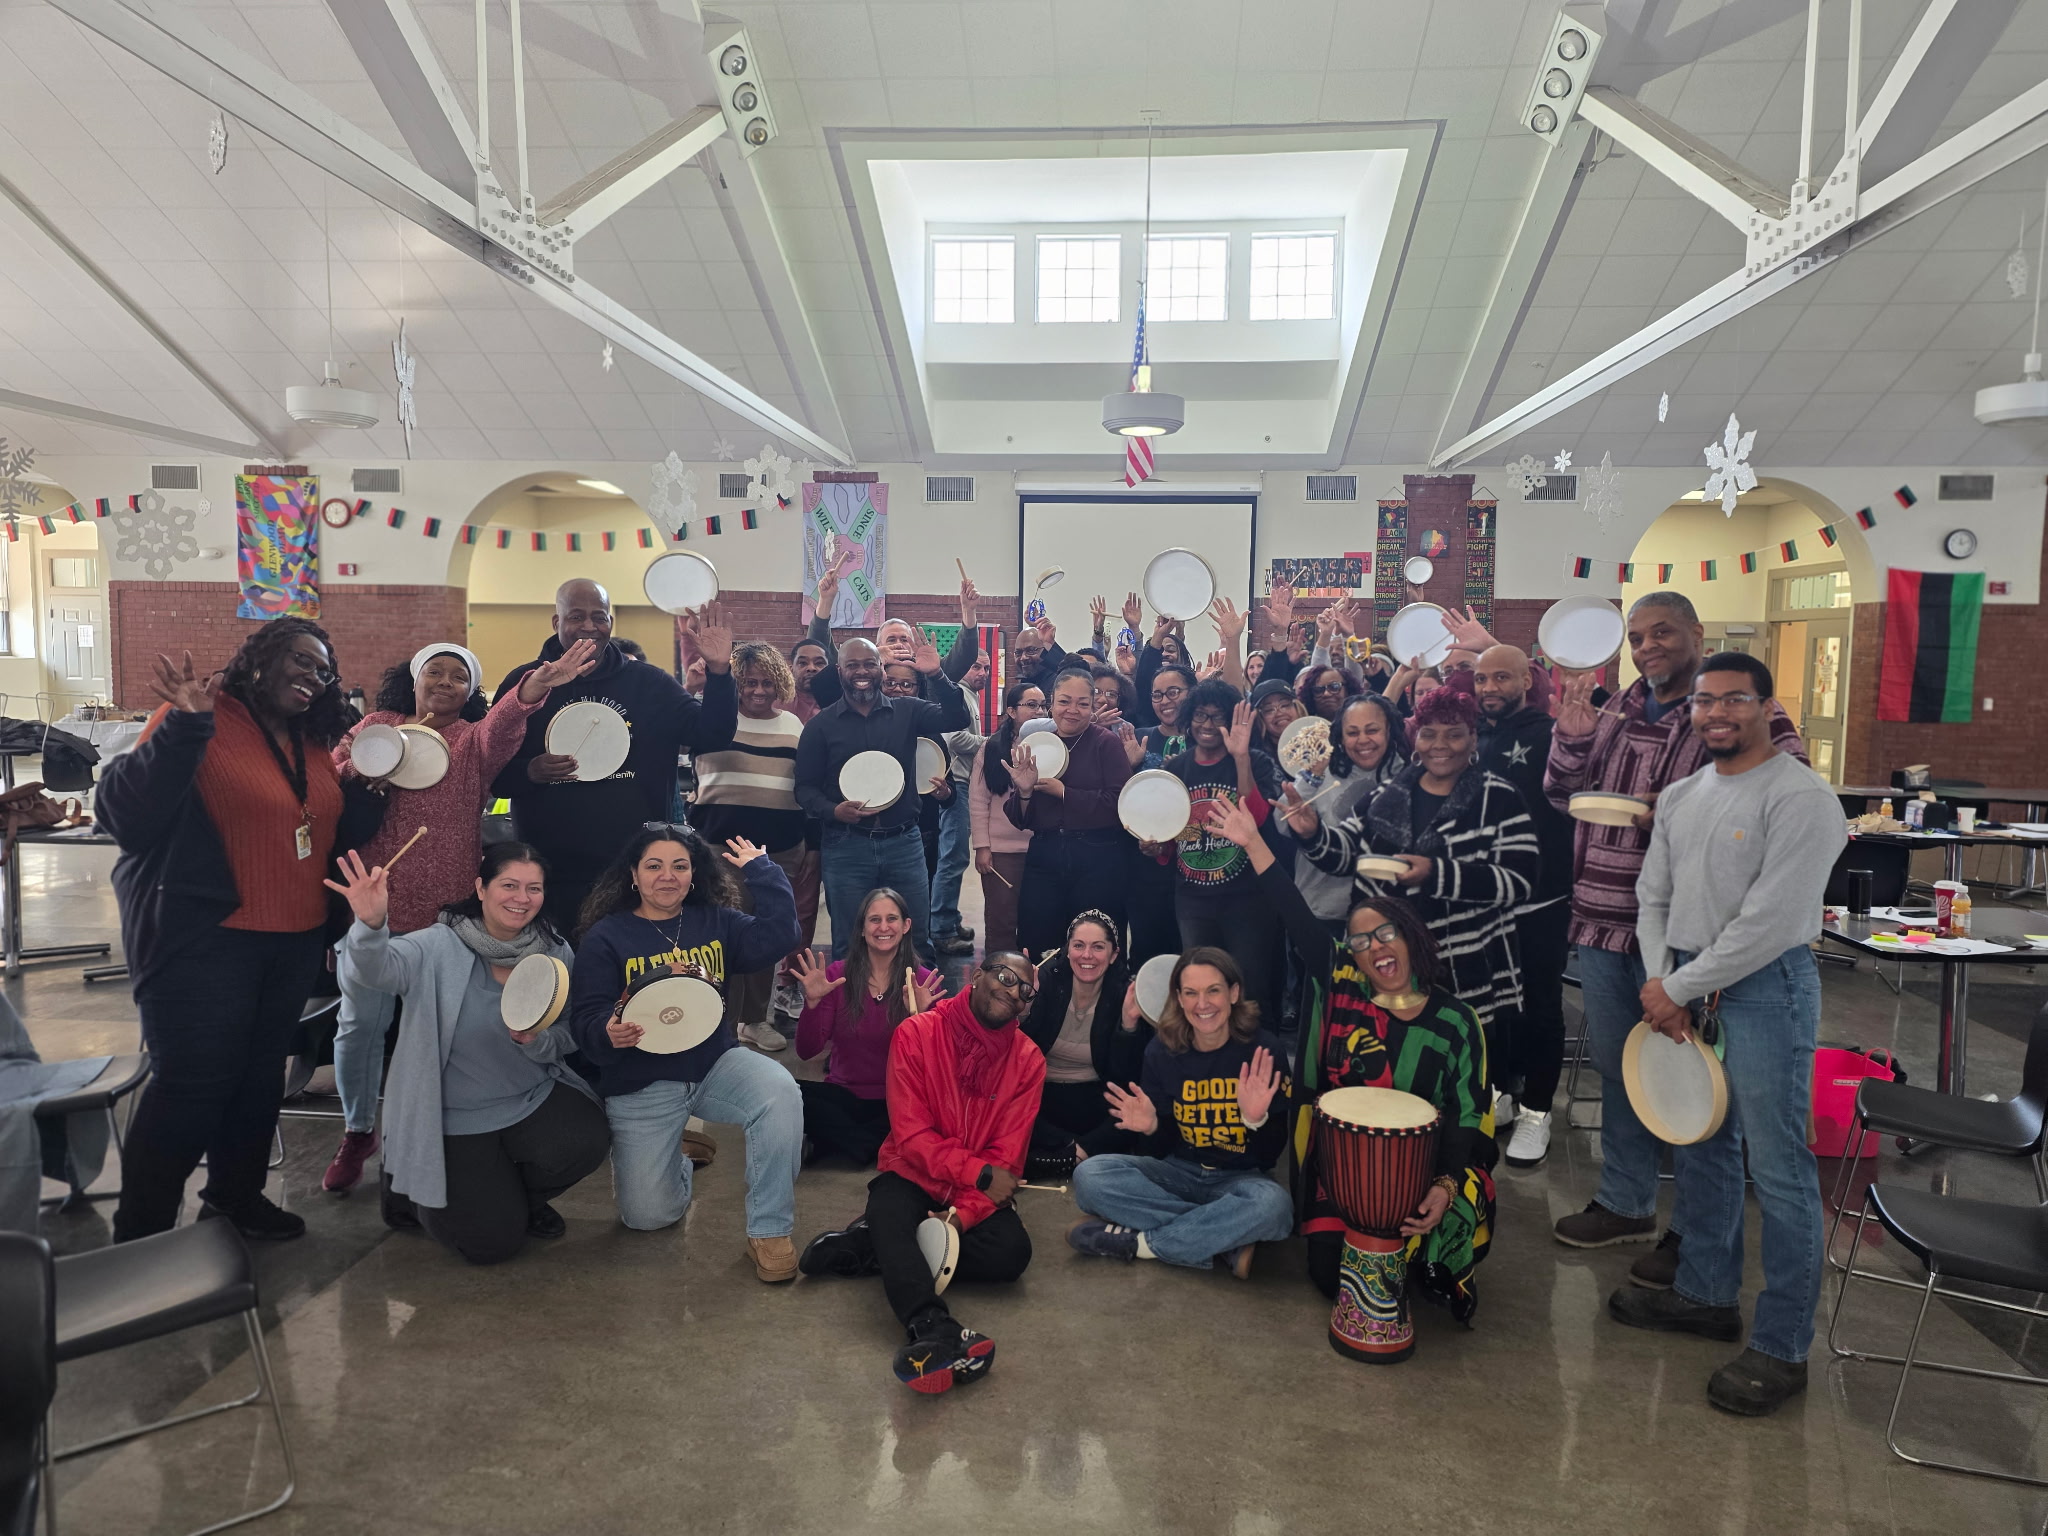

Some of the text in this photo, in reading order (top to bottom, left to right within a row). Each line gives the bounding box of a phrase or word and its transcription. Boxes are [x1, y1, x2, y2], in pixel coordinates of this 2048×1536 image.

[852, 508, 875, 540] SINCE
[1380, 529, 1404, 537] BLACK
[1467, 529, 1495, 537] HISTRY
[267, 519, 277, 578] GLENWOOD
[853, 576, 872, 602] CATS
[1289, 572, 1360, 584] ISTORY
[1208, 868, 1227, 881] THE
[1182, 1078, 1240, 1102] GOOD
[1173, 1100, 1242, 1124] BETTE
